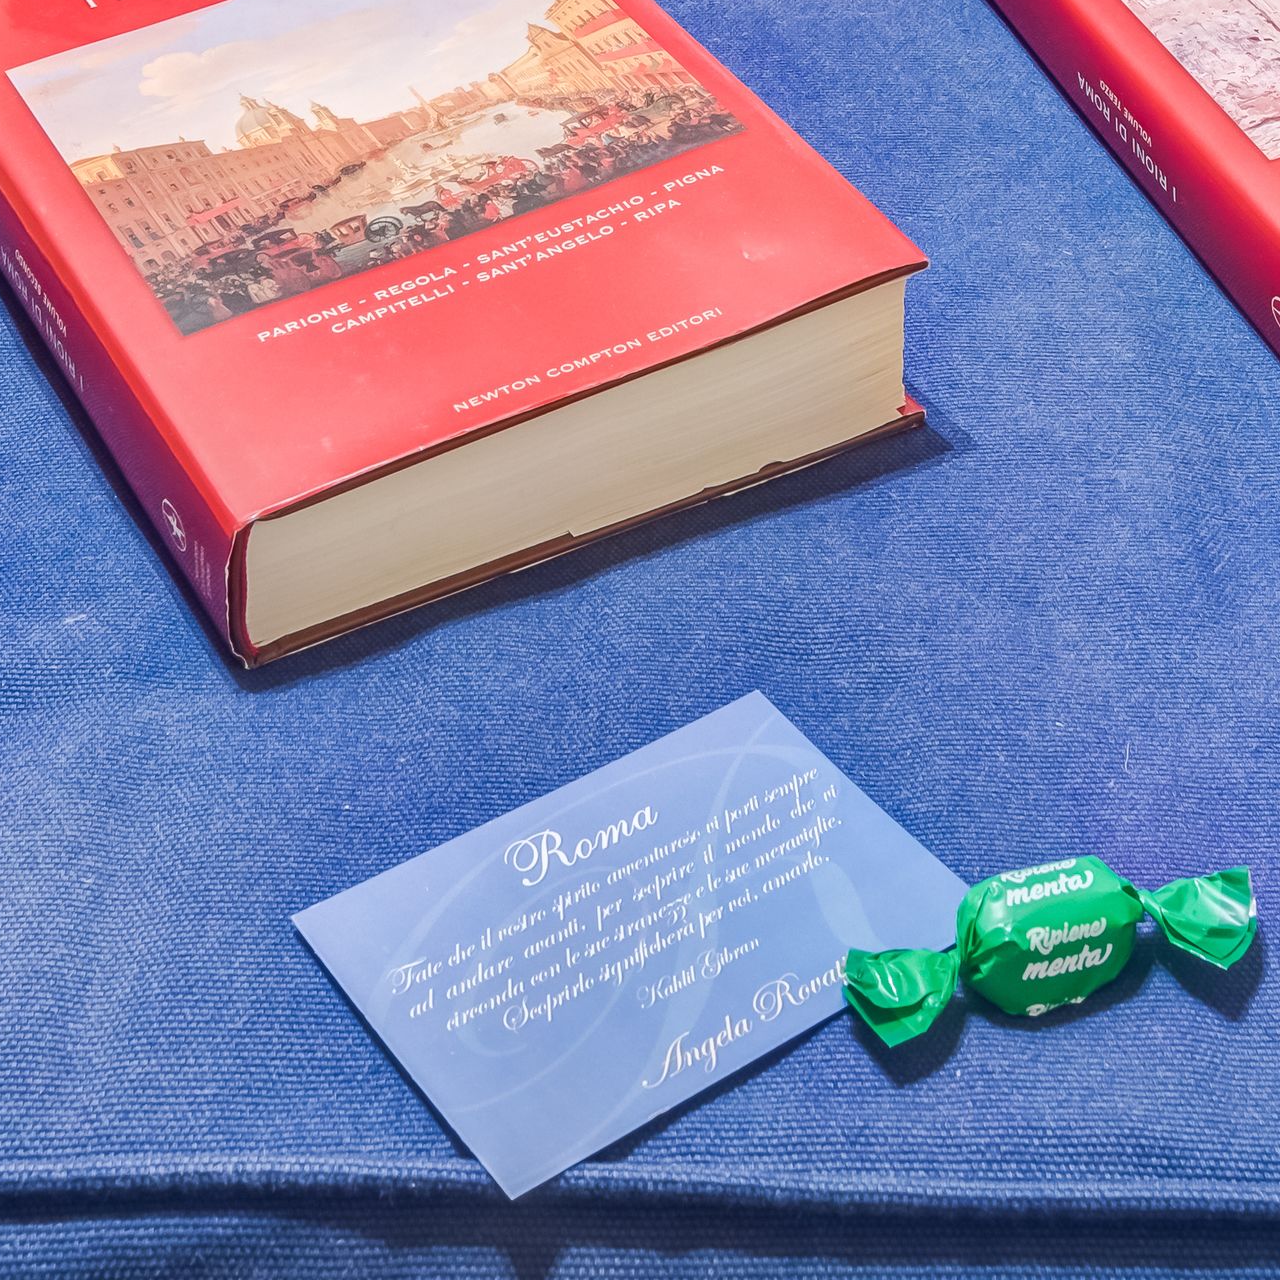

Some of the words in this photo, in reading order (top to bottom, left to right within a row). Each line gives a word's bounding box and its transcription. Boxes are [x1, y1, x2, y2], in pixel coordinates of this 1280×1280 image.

[1100, 80, 1121, 111] TERZO
[1124, 107, 1152, 147] VOLUME
[452, 374, 542, 413] NEWTON
[546, 338, 642, 379] COMPTON
[647, 306, 723, 343] EDITORI
[503, 805, 658, 888] Roma
[384, 956, 443, 996] Fate
[448, 938, 475, 966] che
[480, 928, 492, 949] il
[498, 909, 546, 940] vostro
[552, 879, 600, 922] spirito
[607, 828, 701, 884] avventuroso
[706, 815, 720, 835] vi
[724, 795, 759, 833] porti
[764, 768, 819, 812] sempre
[1006, 870, 1094, 906] menta
[1022, 944, 1113, 982] menta
[1026, 917, 1107, 953] Ripiene
[636, 965, 695, 1009] Kahlil
[697, 937, 761, 979] Gibran
[642, 1014, 753, 1088] Angela
